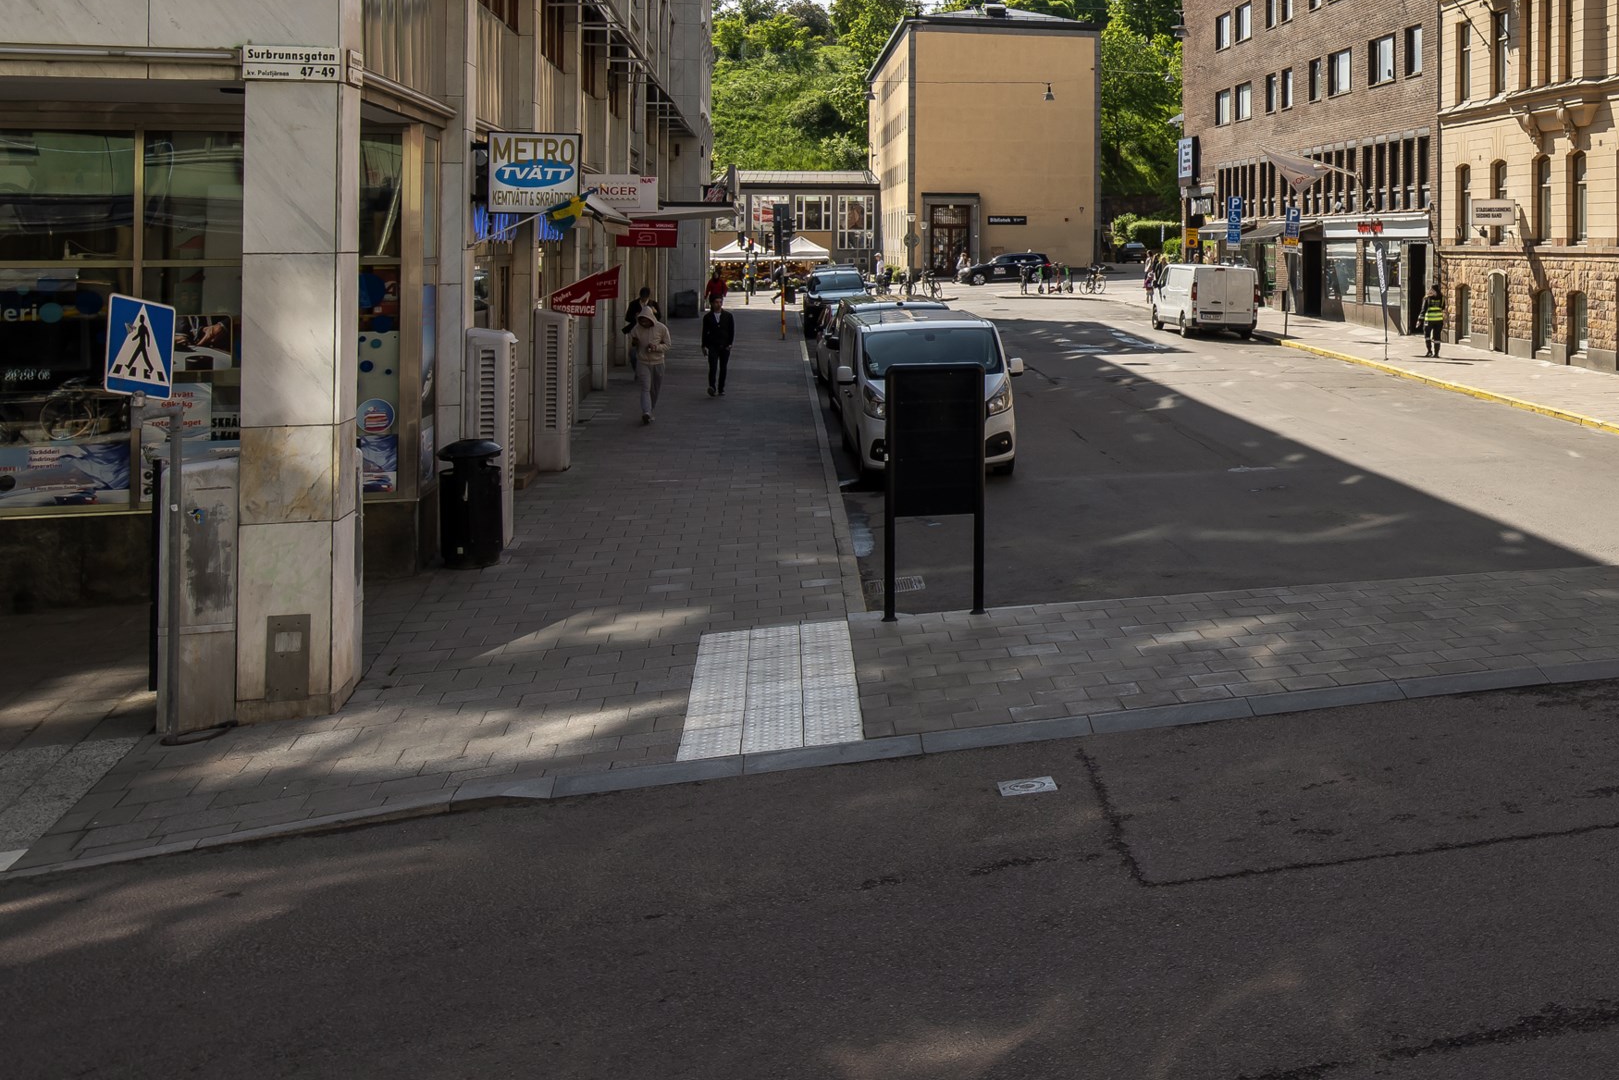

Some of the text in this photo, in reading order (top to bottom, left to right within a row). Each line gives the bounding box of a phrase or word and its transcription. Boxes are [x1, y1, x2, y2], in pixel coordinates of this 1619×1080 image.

[247, 49, 336, 63] Surbrunnsgatan
[300, 66, 336, 78] 47-49
[492, 137, 575, 165] METRO
[501, 165, 571, 180] TVÄTT
[492, 188, 529, 206] KEMTVÄTT
[529, 191, 535, 207] &
